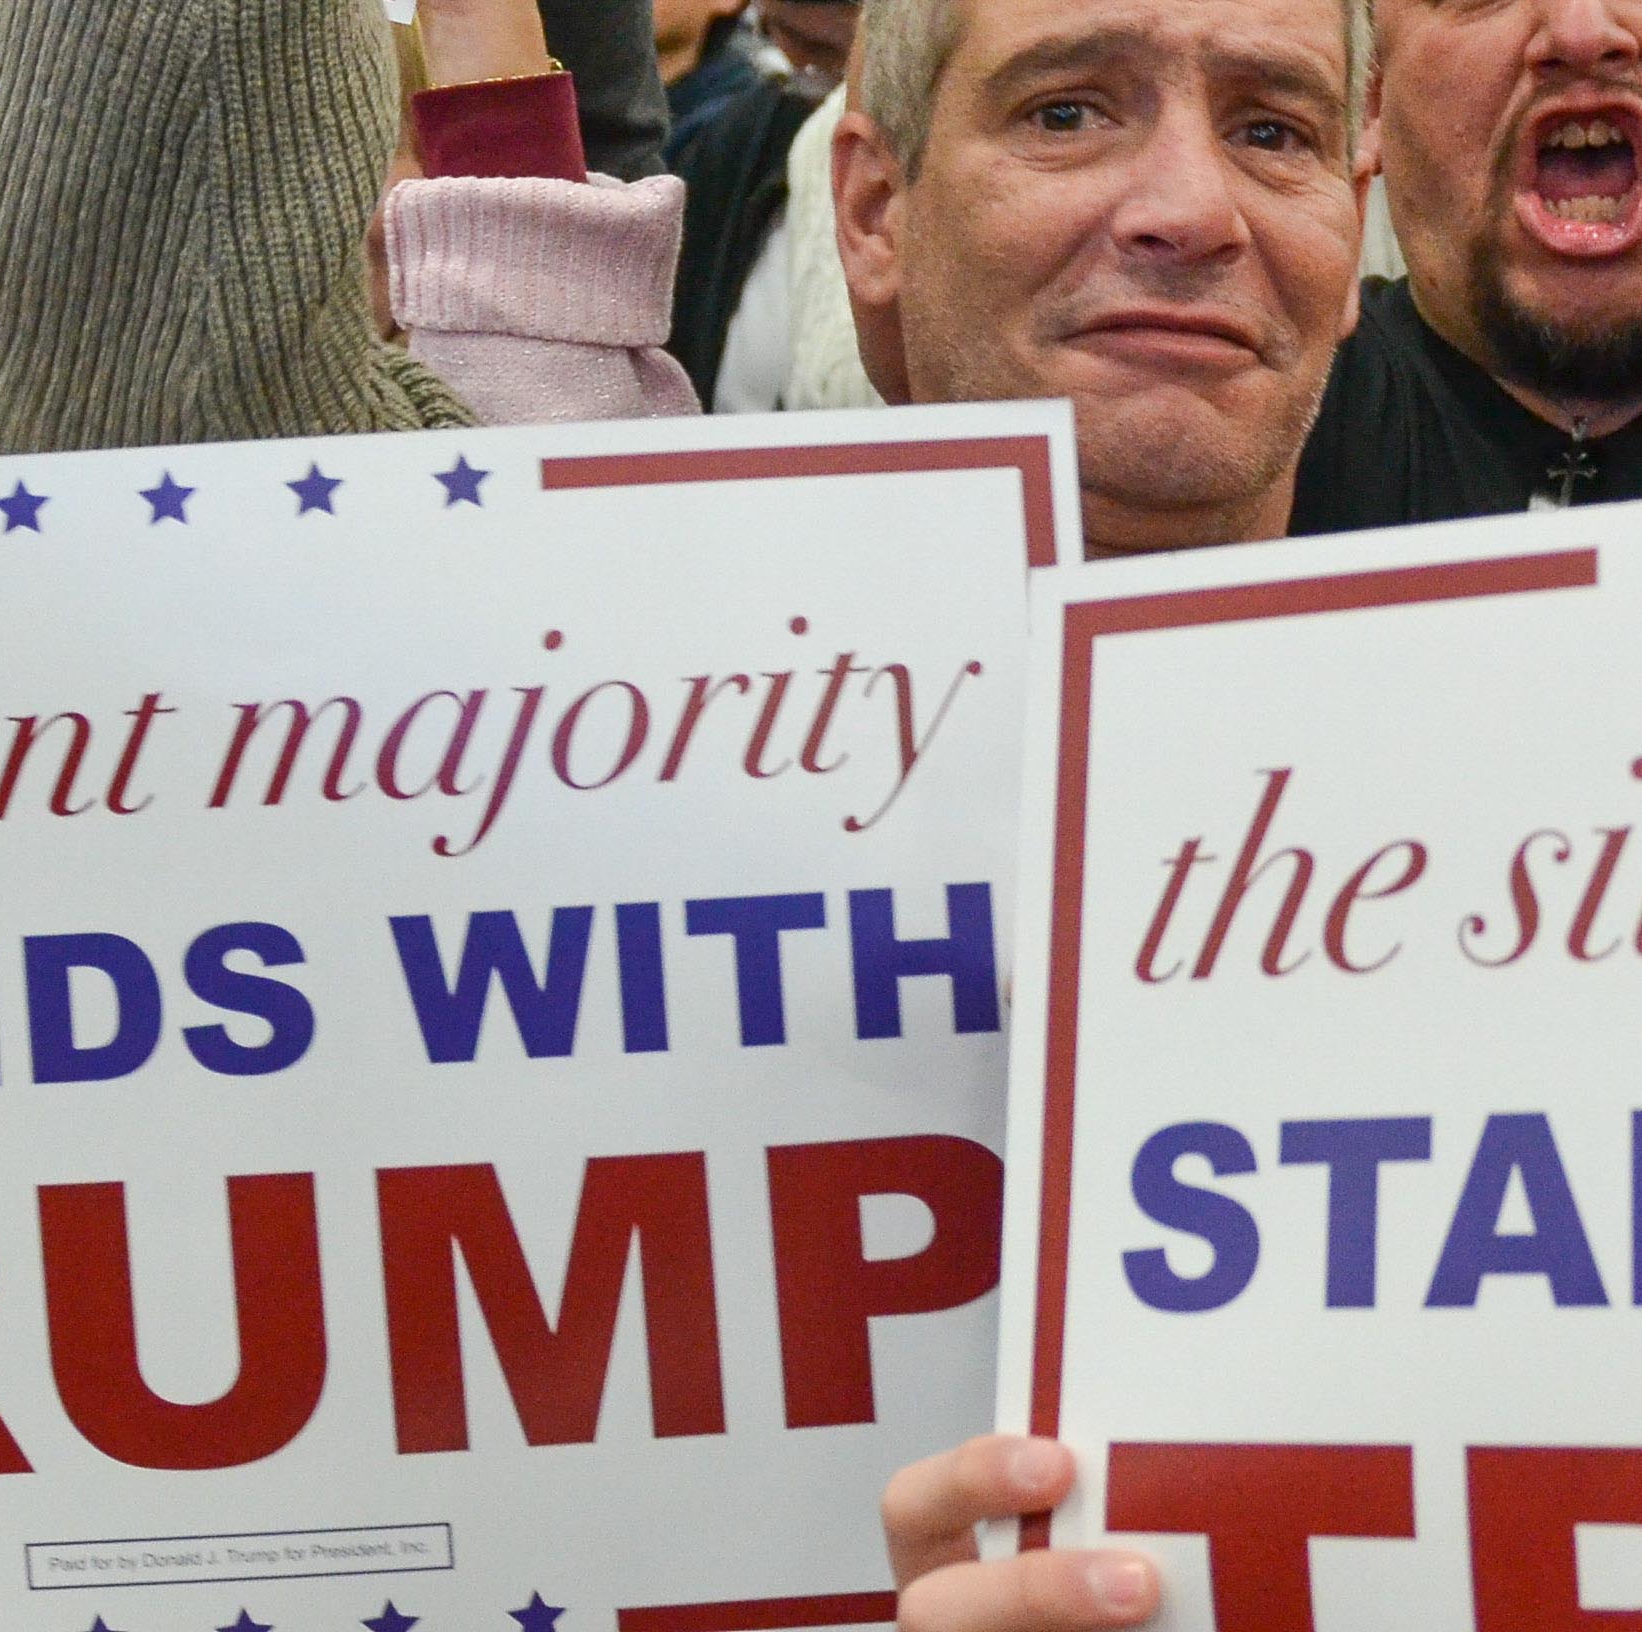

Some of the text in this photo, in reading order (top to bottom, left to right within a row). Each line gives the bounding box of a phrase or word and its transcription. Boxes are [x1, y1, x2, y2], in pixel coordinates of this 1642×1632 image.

[205, 616, 982, 857] majority
[389, 882, 1002, 1063] WITH
[1133, 767, 1429, 985] the
[141, 1551, 202, 1569] Donald
[227, 1547, 279, 1567] Trump
